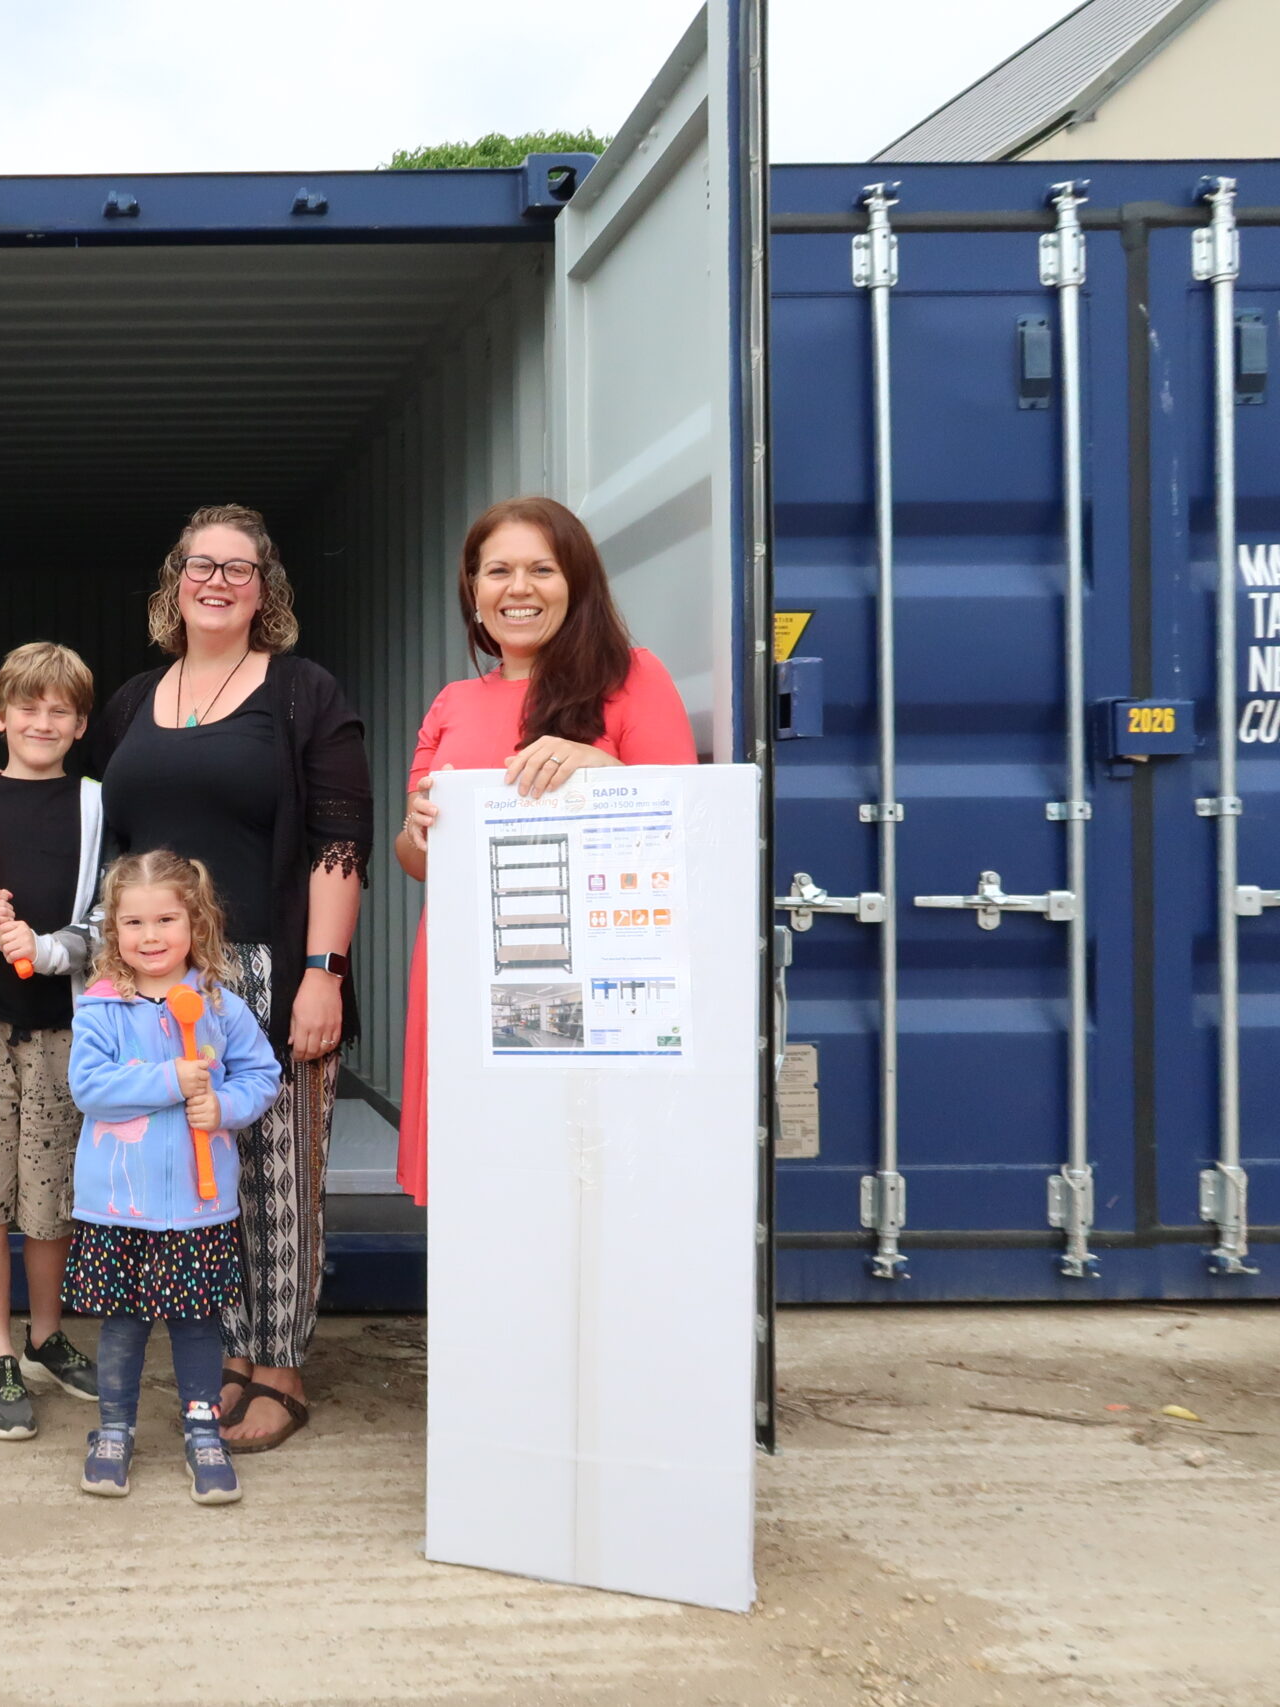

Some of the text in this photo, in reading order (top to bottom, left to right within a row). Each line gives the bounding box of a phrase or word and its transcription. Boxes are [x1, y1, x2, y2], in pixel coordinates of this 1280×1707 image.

[1128, 707, 1175, 733] 2026
[592, 787, 638, 798] RAPID 3
